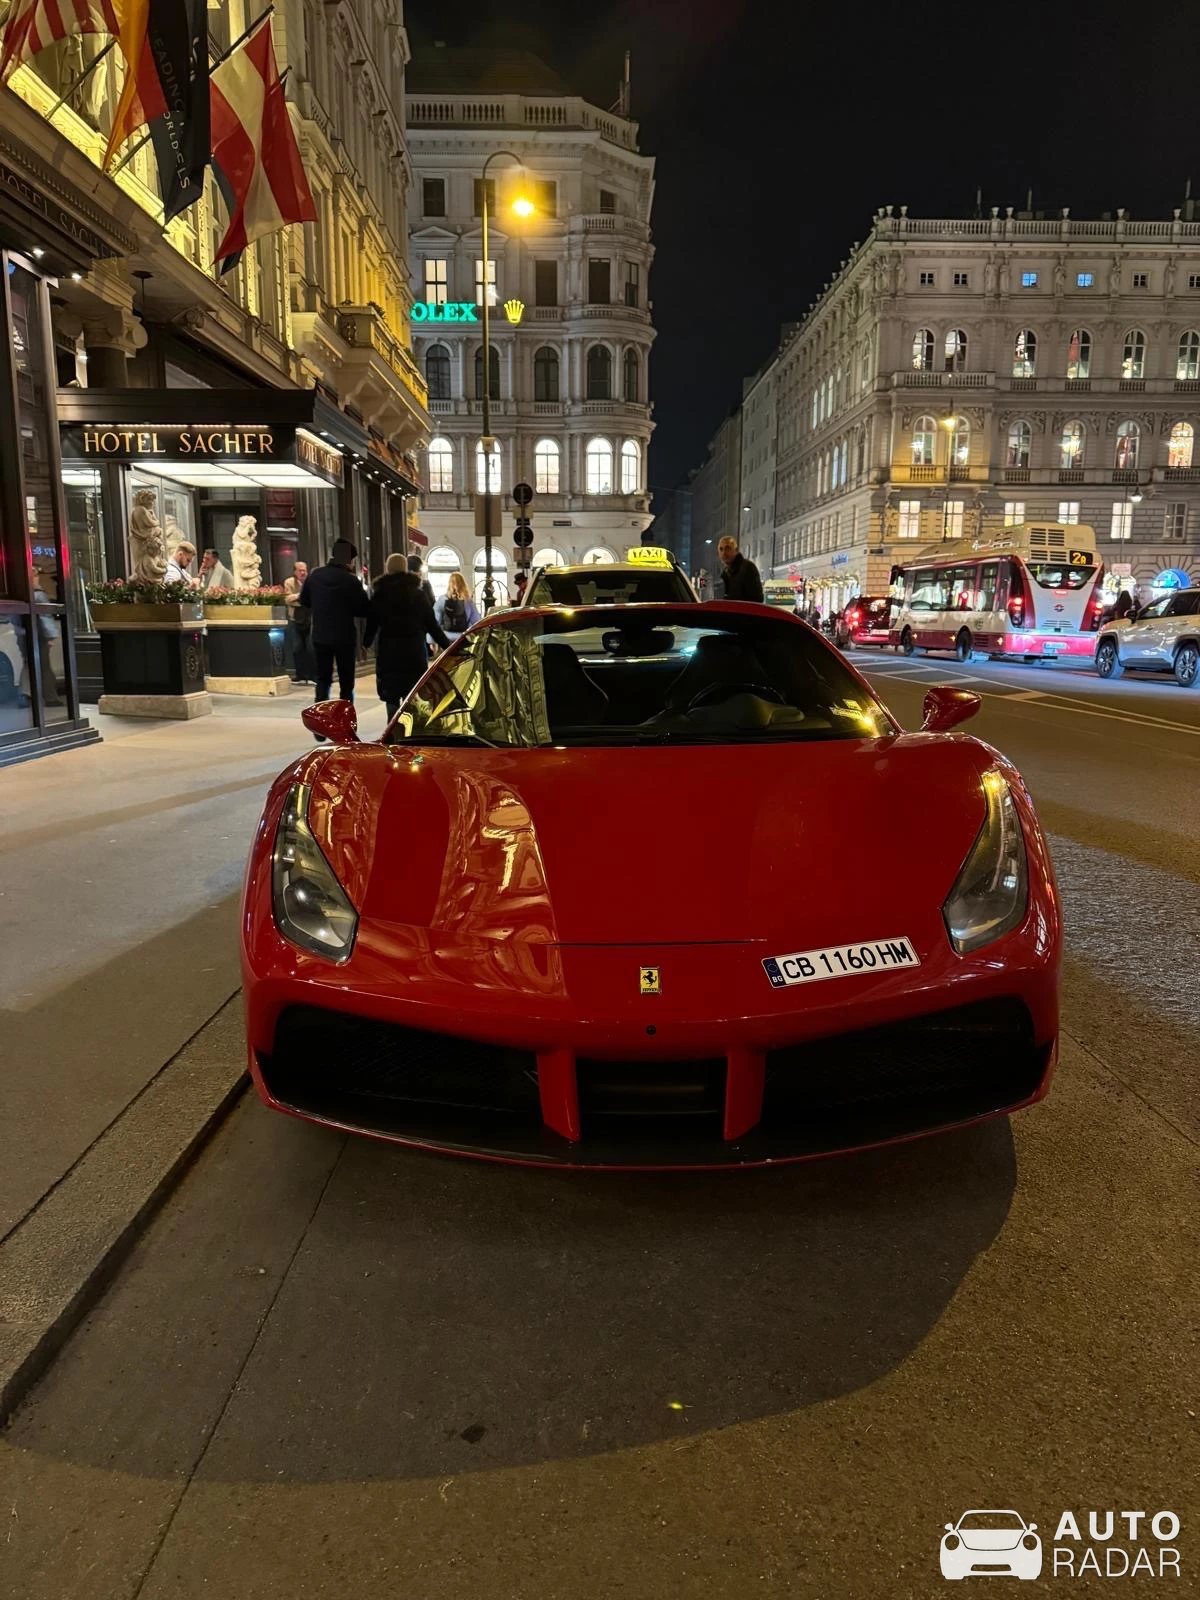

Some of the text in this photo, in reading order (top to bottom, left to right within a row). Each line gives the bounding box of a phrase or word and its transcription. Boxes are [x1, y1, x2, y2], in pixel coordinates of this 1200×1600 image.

[411, 303, 478, 321] OLEX
[83, 432, 274, 454] HOTEL SACHER
[631, 549, 663, 558] TAXI
[782, 941, 914, 979] CB 1160 HM
[771, 975, 784, 983] BG
